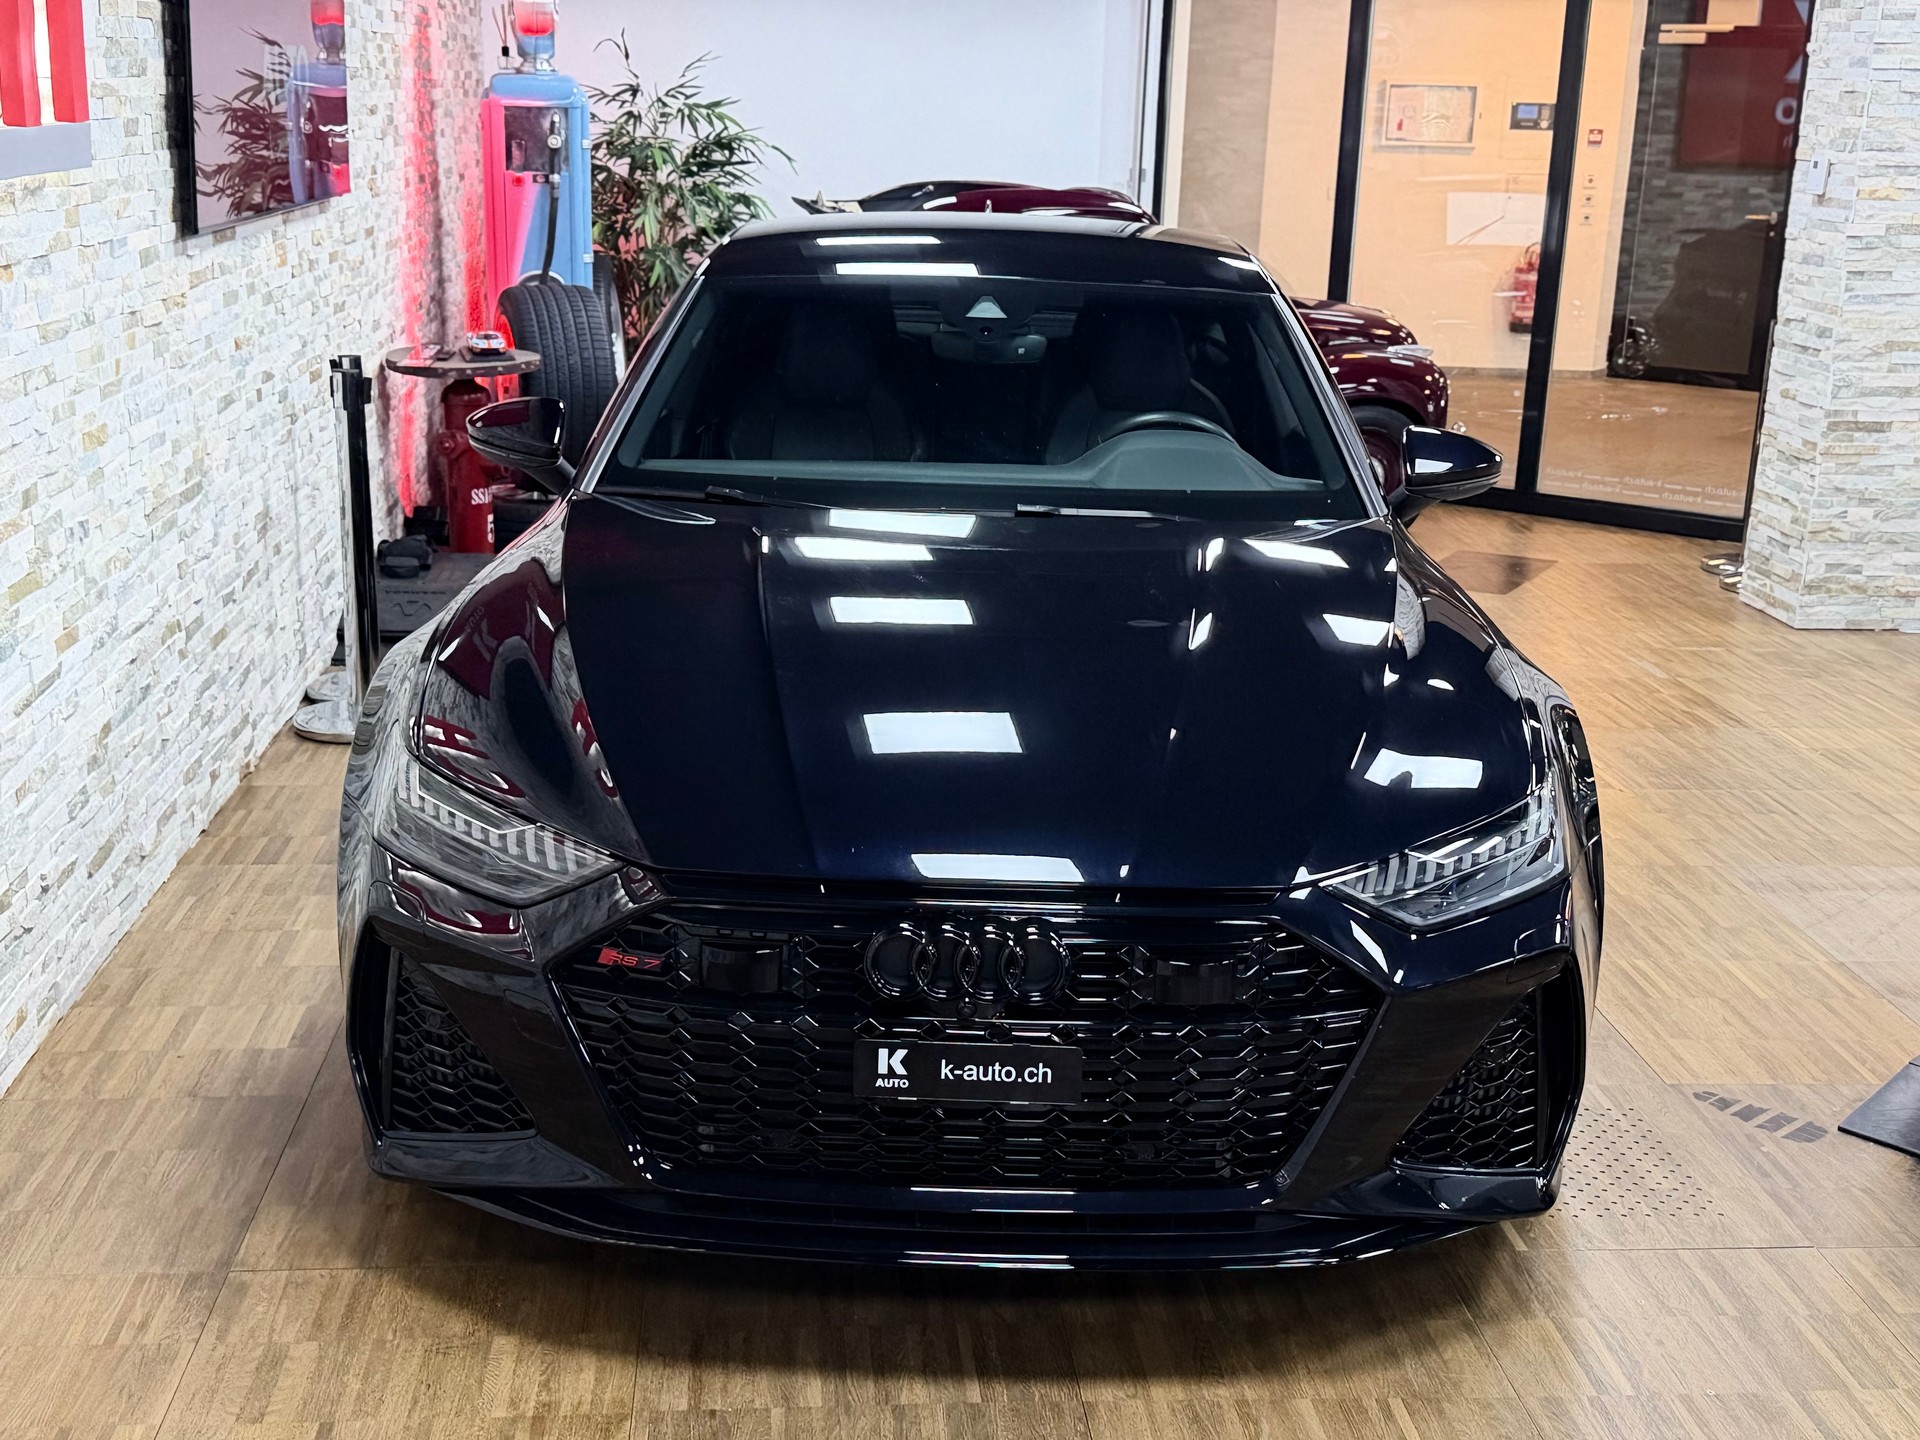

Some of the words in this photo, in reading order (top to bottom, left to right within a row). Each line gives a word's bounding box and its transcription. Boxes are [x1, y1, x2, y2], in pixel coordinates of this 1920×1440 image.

[877, 1048, 909, 1075] K
[940, 1059, 1052, 1083] k-auto.ch
[875, 1078, 909, 1088] AUTO
